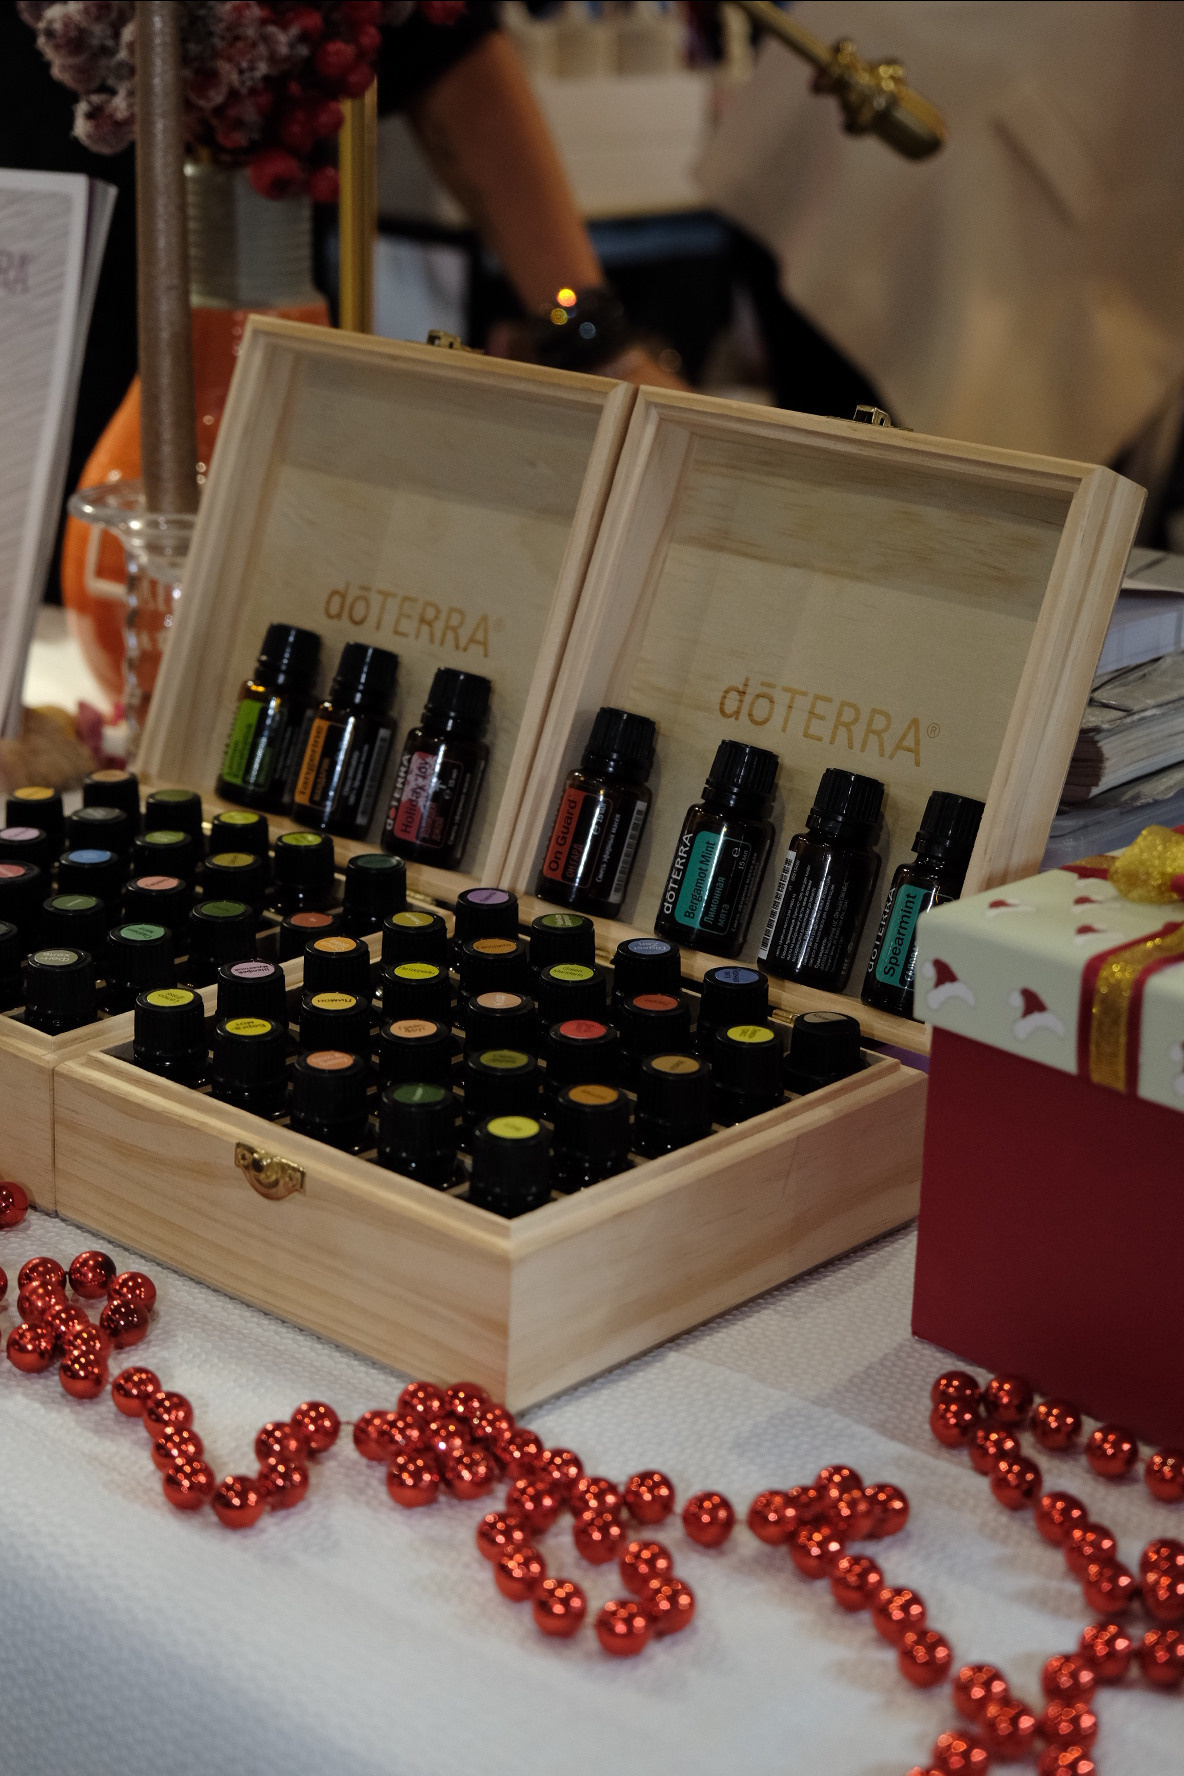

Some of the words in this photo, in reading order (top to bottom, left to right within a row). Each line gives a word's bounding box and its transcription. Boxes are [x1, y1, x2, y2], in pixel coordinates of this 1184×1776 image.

[400, 783, 426, 835] Holiday
[555, 798, 578, 847] Guard
[548, 849, 564, 872] On
[684, 866, 710, 920] Bergamot
[699, 840, 716, 866] Mint
[737, 860, 746, 870] 15
[703, 875, 726, 925] Лимонная
[716, 902, 731, 927] мята
[882, 891, 918, 978] Spearmint
